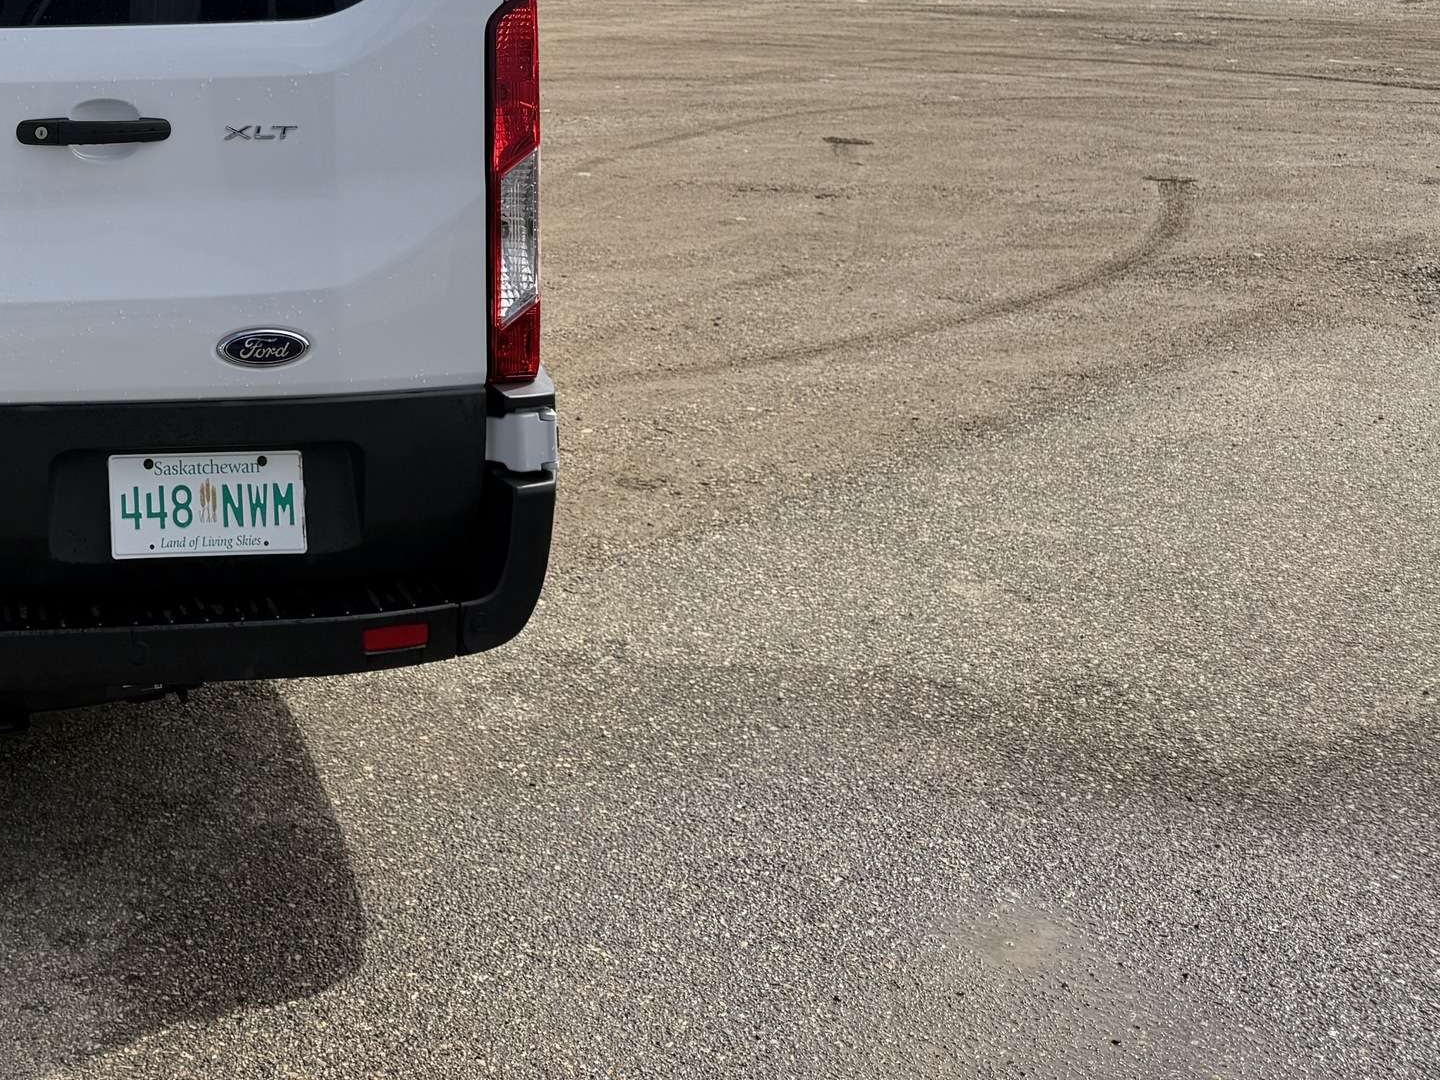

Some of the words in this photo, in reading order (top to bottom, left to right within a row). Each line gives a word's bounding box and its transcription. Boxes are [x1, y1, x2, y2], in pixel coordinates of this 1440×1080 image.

[224, 125, 298, 141] XLT
[240, 337, 290, 359] Ford
[154, 459, 261, 476] Saskatchewan
[121, 484, 193, 530] 448
[221, 482, 295, 528] NWM
[160, 536, 186, 549] Land
[188, 536, 200, 550] of
[201, 536, 233, 550] Living
[235, 535, 262, 547] Skies
